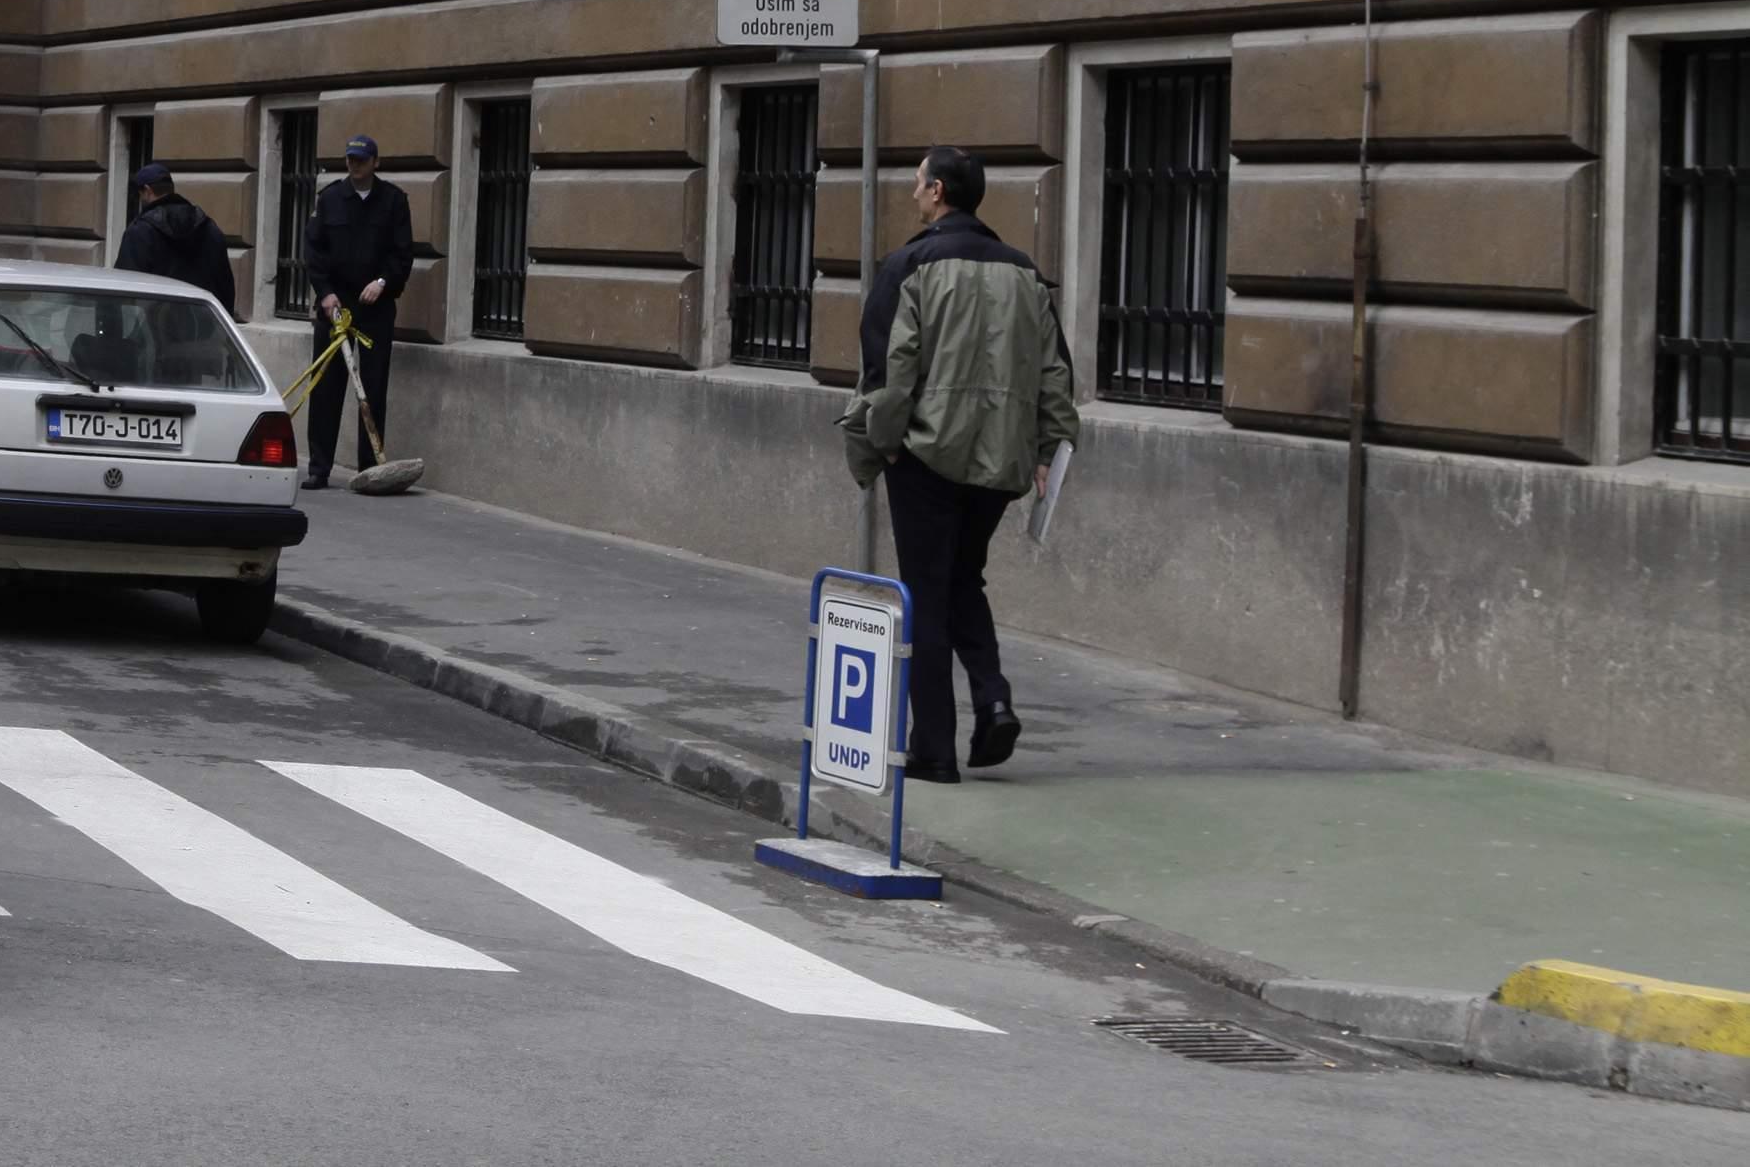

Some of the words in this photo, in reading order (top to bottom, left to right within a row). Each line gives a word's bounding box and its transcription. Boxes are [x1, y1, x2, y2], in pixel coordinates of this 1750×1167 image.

[741, 18, 835, 40] odobrenjem
[64, 413, 178, 441] T70-J-014
[827, 611, 886, 636] Rezervisano
[838, 653, 868, 720] P
[828, 742, 871, 771] UNDP
